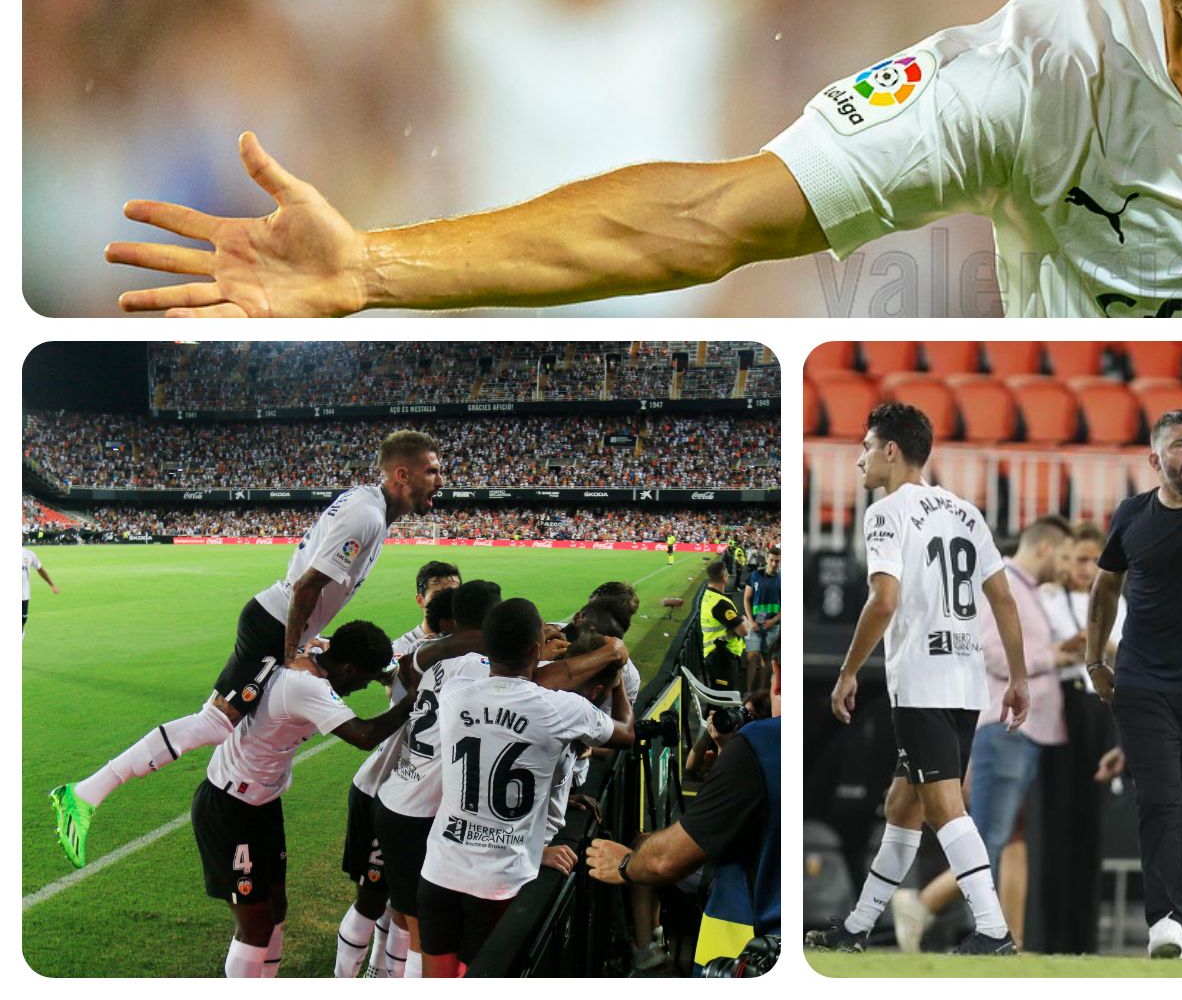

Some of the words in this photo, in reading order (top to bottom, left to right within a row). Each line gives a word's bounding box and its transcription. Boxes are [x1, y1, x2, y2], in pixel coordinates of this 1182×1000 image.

[927, 536, 977, 621] 18
[460, 710, 481, 728] S.
[484, 707, 530, 735] LINO
[451, 736, 536, 822] 16
[233, 843, 253, 875] 4
